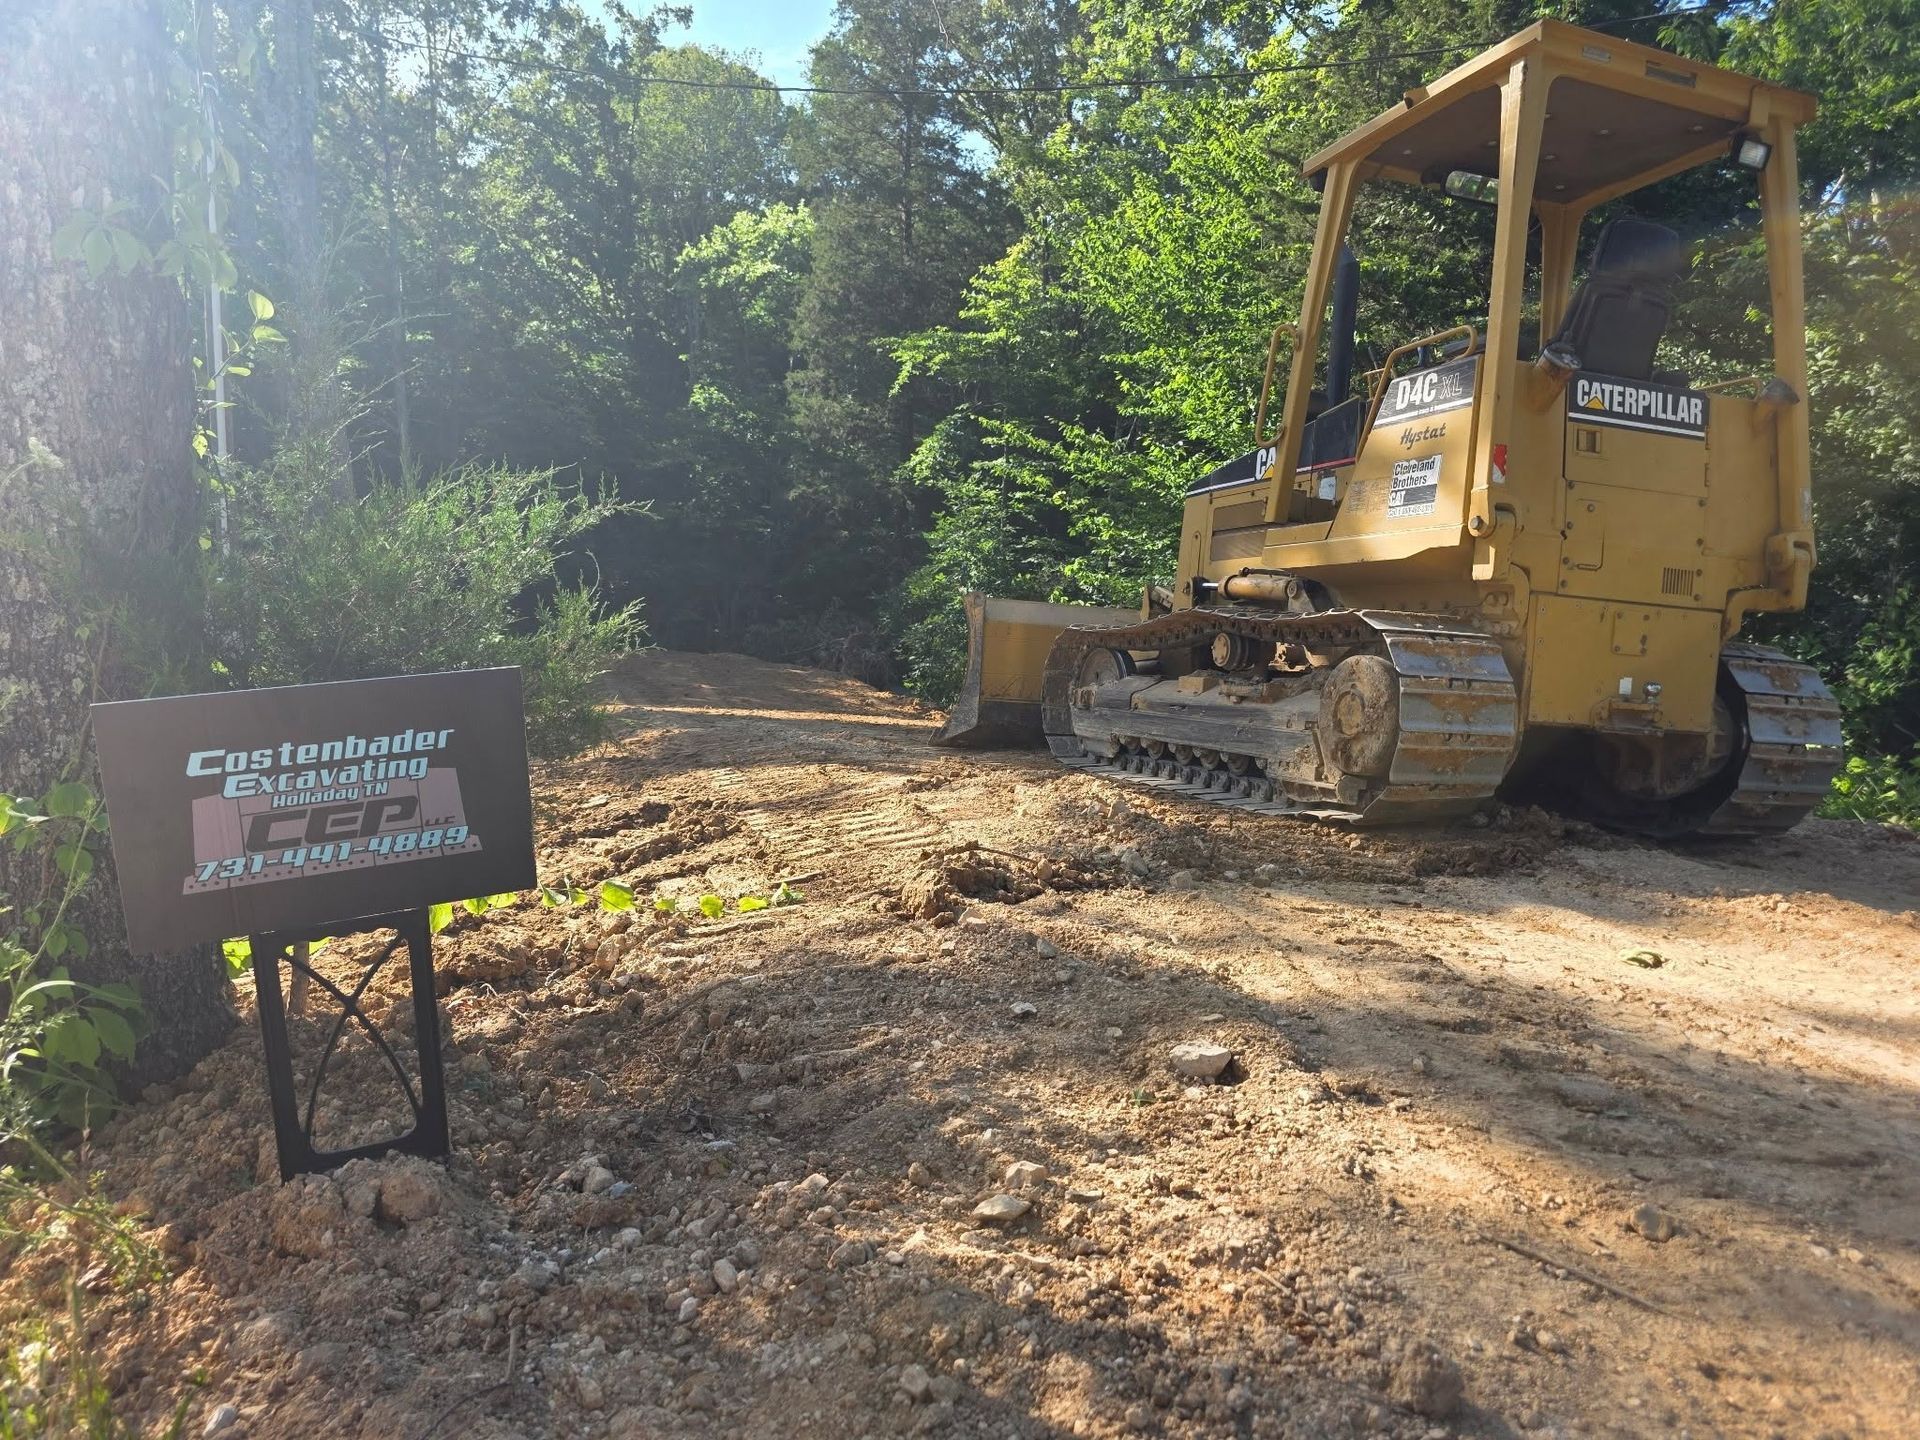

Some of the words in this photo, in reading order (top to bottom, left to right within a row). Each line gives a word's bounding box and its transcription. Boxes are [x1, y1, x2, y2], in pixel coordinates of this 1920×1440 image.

[1396, 372, 1438, 410] D4C
[1440, 372, 1463, 400] XL
[1577, 379, 1702, 425] CATERPILLAR
[1400, 423, 1447, 450] Hystat
[1255, 446, 1277, 480] CA
[1392, 474, 1427, 489] Brothers
[1394, 457, 1435, 476] Cleveland
[185, 728, 456, 777] Costenbader
[221, 757, 429, 799] Excavating
[272, 787, 359, 809] Holladay
[363, 781, 389, 796] TN
[245, 795, 420, 853] CEP
[424, 815, 456, 827] LLC
[195, 825, 470, 883] 731-441-4889
